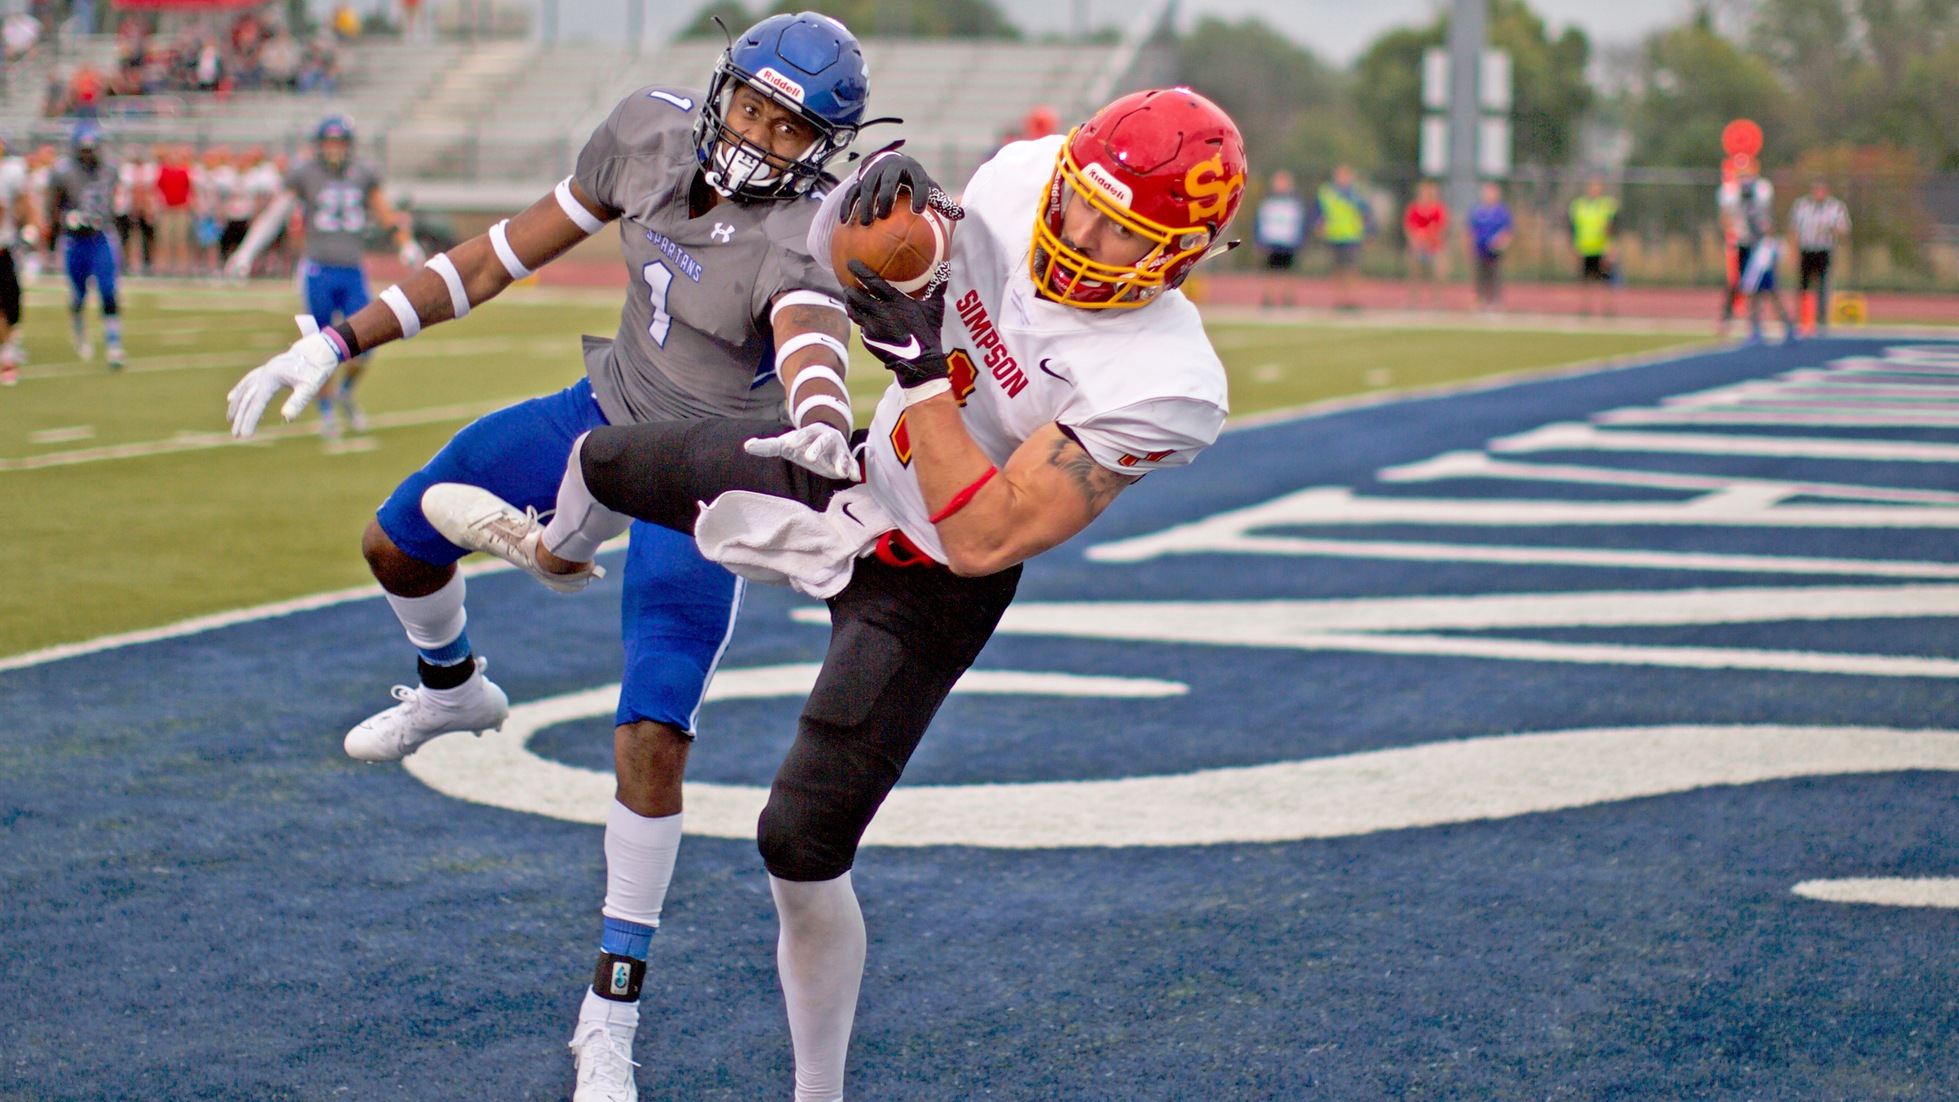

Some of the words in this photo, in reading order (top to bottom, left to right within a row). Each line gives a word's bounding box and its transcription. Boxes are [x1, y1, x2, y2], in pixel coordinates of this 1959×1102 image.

[648, 88, 695, 113] 1
[763, 70, 801, 98] Riddell
[1089, 169, 1125, 200] Riddell
[645, 228, 704, 284] SPARTANS
[642, 259, 675, 350] 1
[955, 289, 1030, 399] SIMPSON
